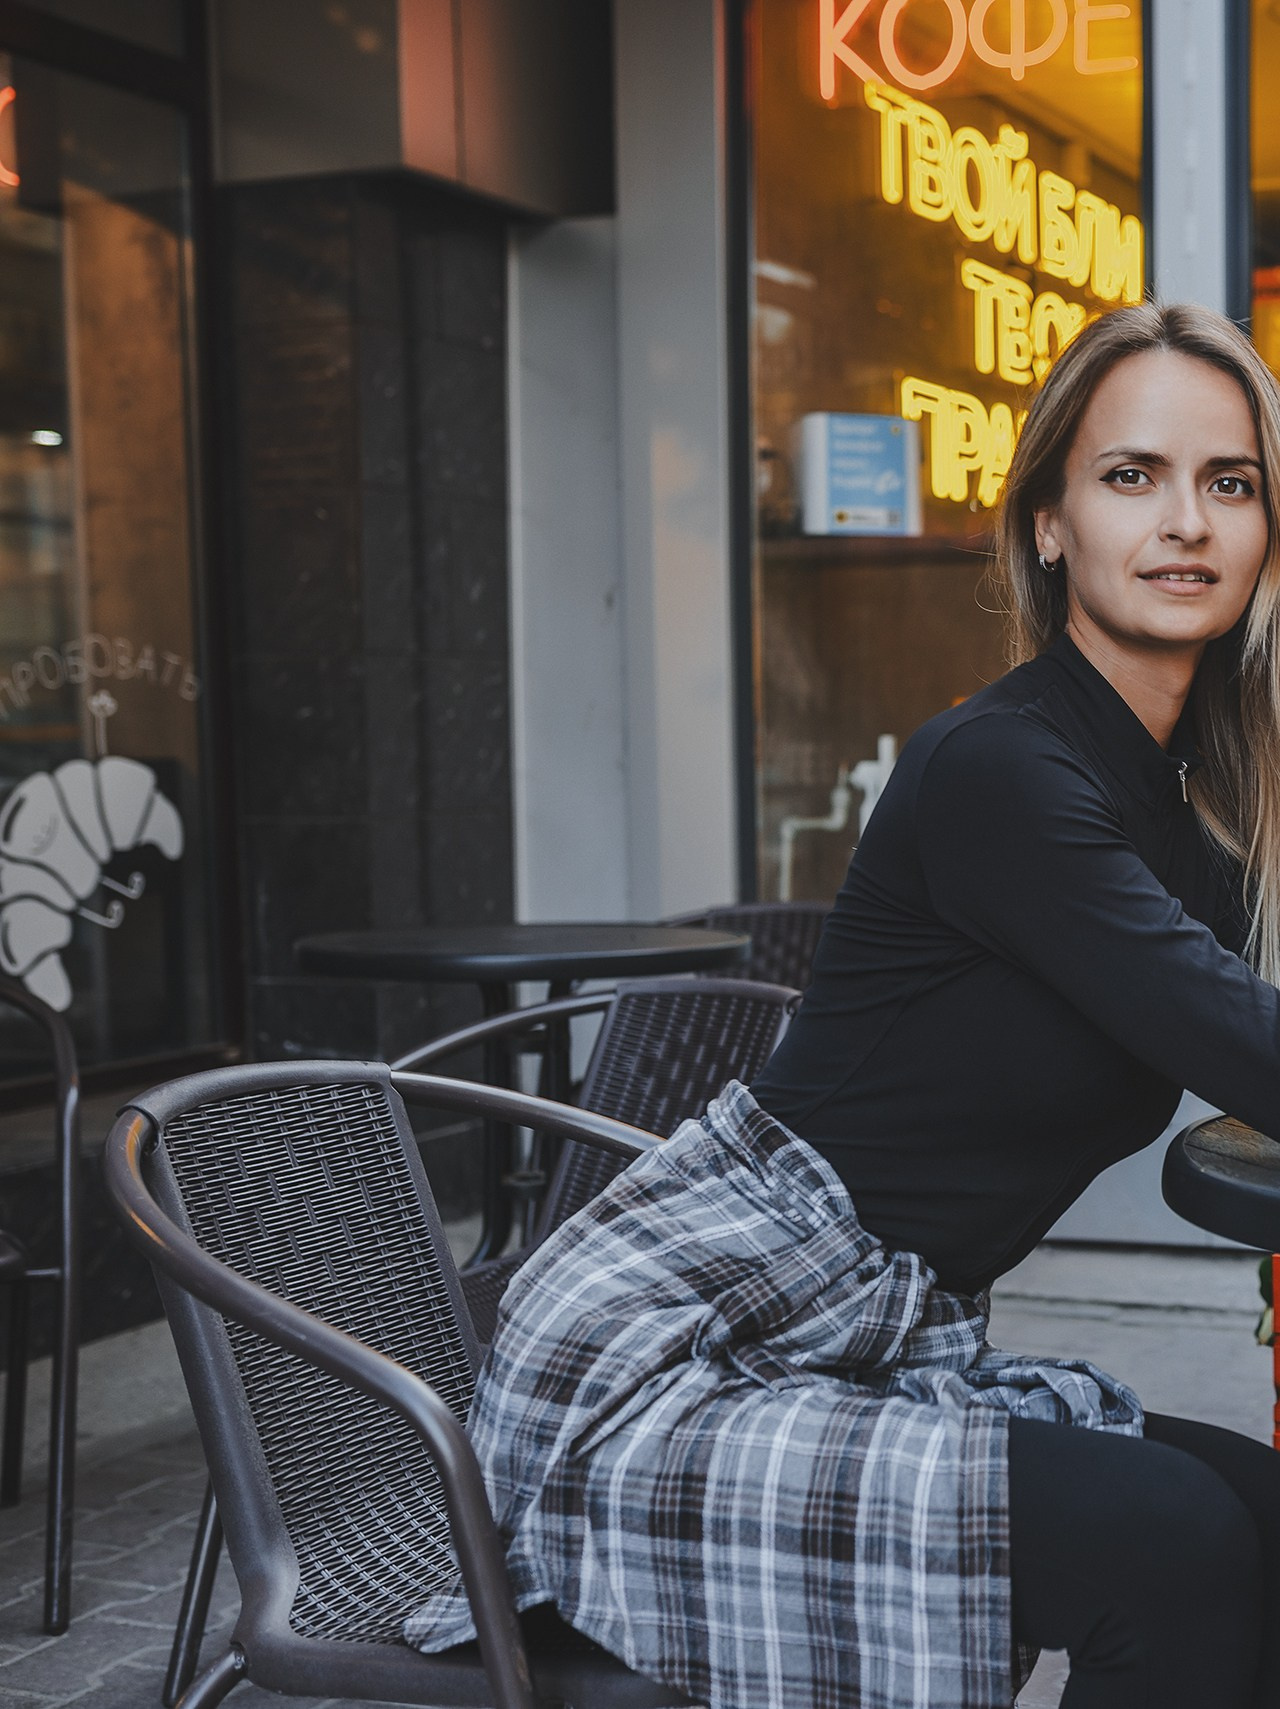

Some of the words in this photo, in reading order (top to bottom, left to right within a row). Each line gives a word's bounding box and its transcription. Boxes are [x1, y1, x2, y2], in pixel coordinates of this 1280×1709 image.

[819, 0, 1138, 100] КОФЕ
[864, 79, 1037, 264] ТВОЙ
[961, 257, 1094, 385] ТВО
[901, 376, 1028, 507] ПРА
